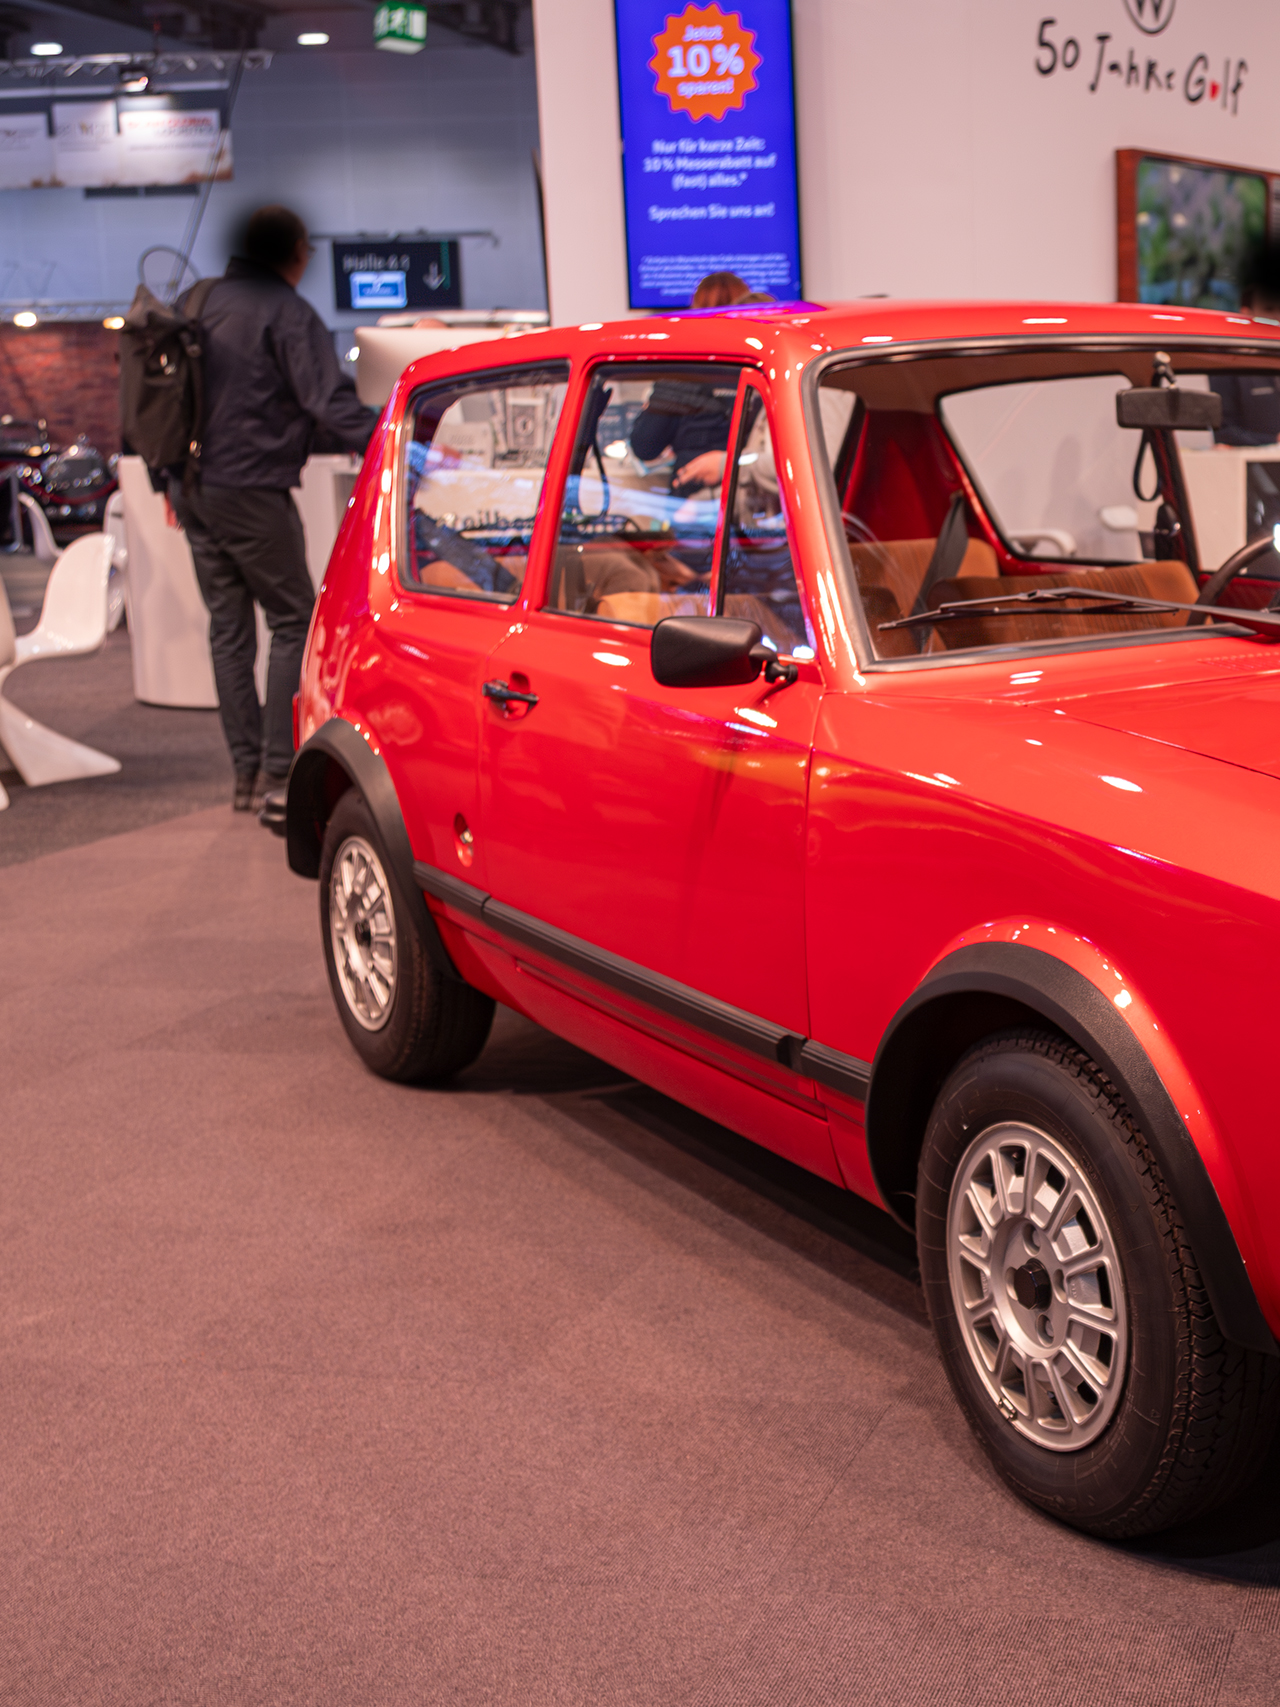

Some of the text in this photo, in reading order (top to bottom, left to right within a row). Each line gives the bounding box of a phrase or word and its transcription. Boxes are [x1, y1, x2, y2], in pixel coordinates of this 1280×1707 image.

[682, 25, 723, 42] Jetzt
[1035, 17, 1079, 77] 50
[1184, 53, 1248, 116] Golf
[677, 77, 734, 98] sparen!
[652, 139, 677, 154] Nur
[678, 138, 697, 154] für
[698, 137, 734, 153] kurze
[754, 153, 777, 169] auf
[648, 204, 707, 223] Sprechen
[708, 203, 728, 219] Sie
[729, 205, 752, 219] uns
[343, 253, 386, 273] Halle
